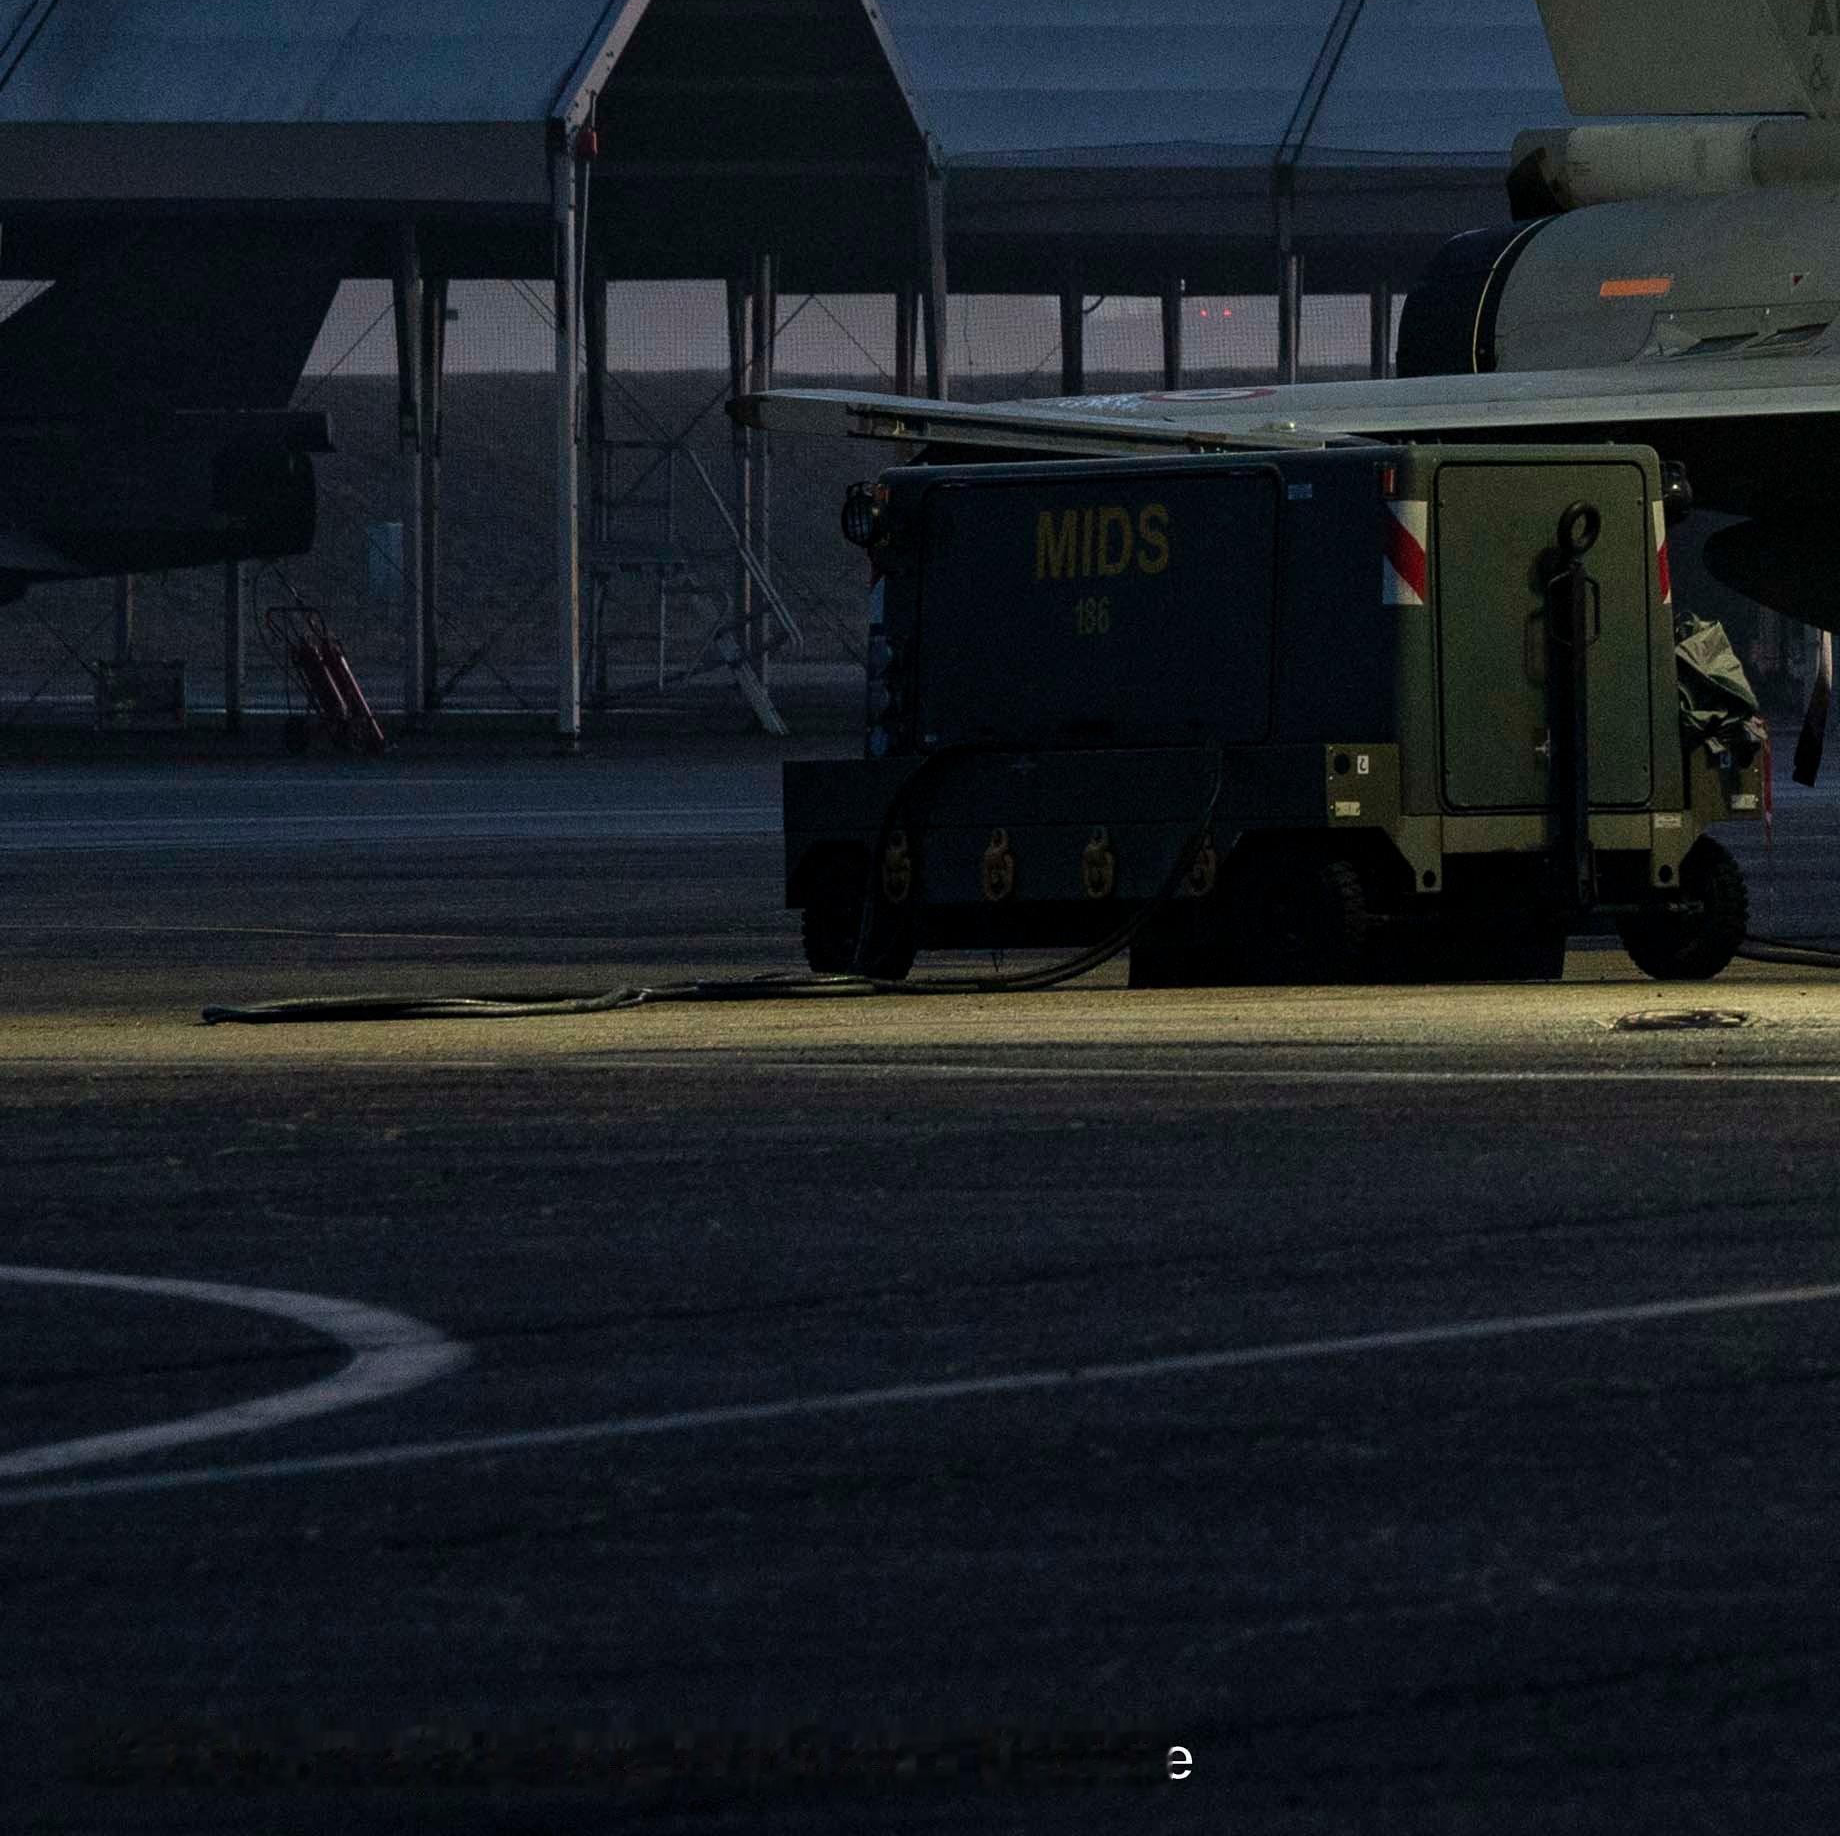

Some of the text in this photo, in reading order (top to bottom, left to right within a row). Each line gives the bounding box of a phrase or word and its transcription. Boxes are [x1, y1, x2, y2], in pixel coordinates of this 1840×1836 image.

[1808, 51, 1831, 92] &
[1034, 503, 1170, 580] MIDS
[1075, 595, 1111, 634] 186
